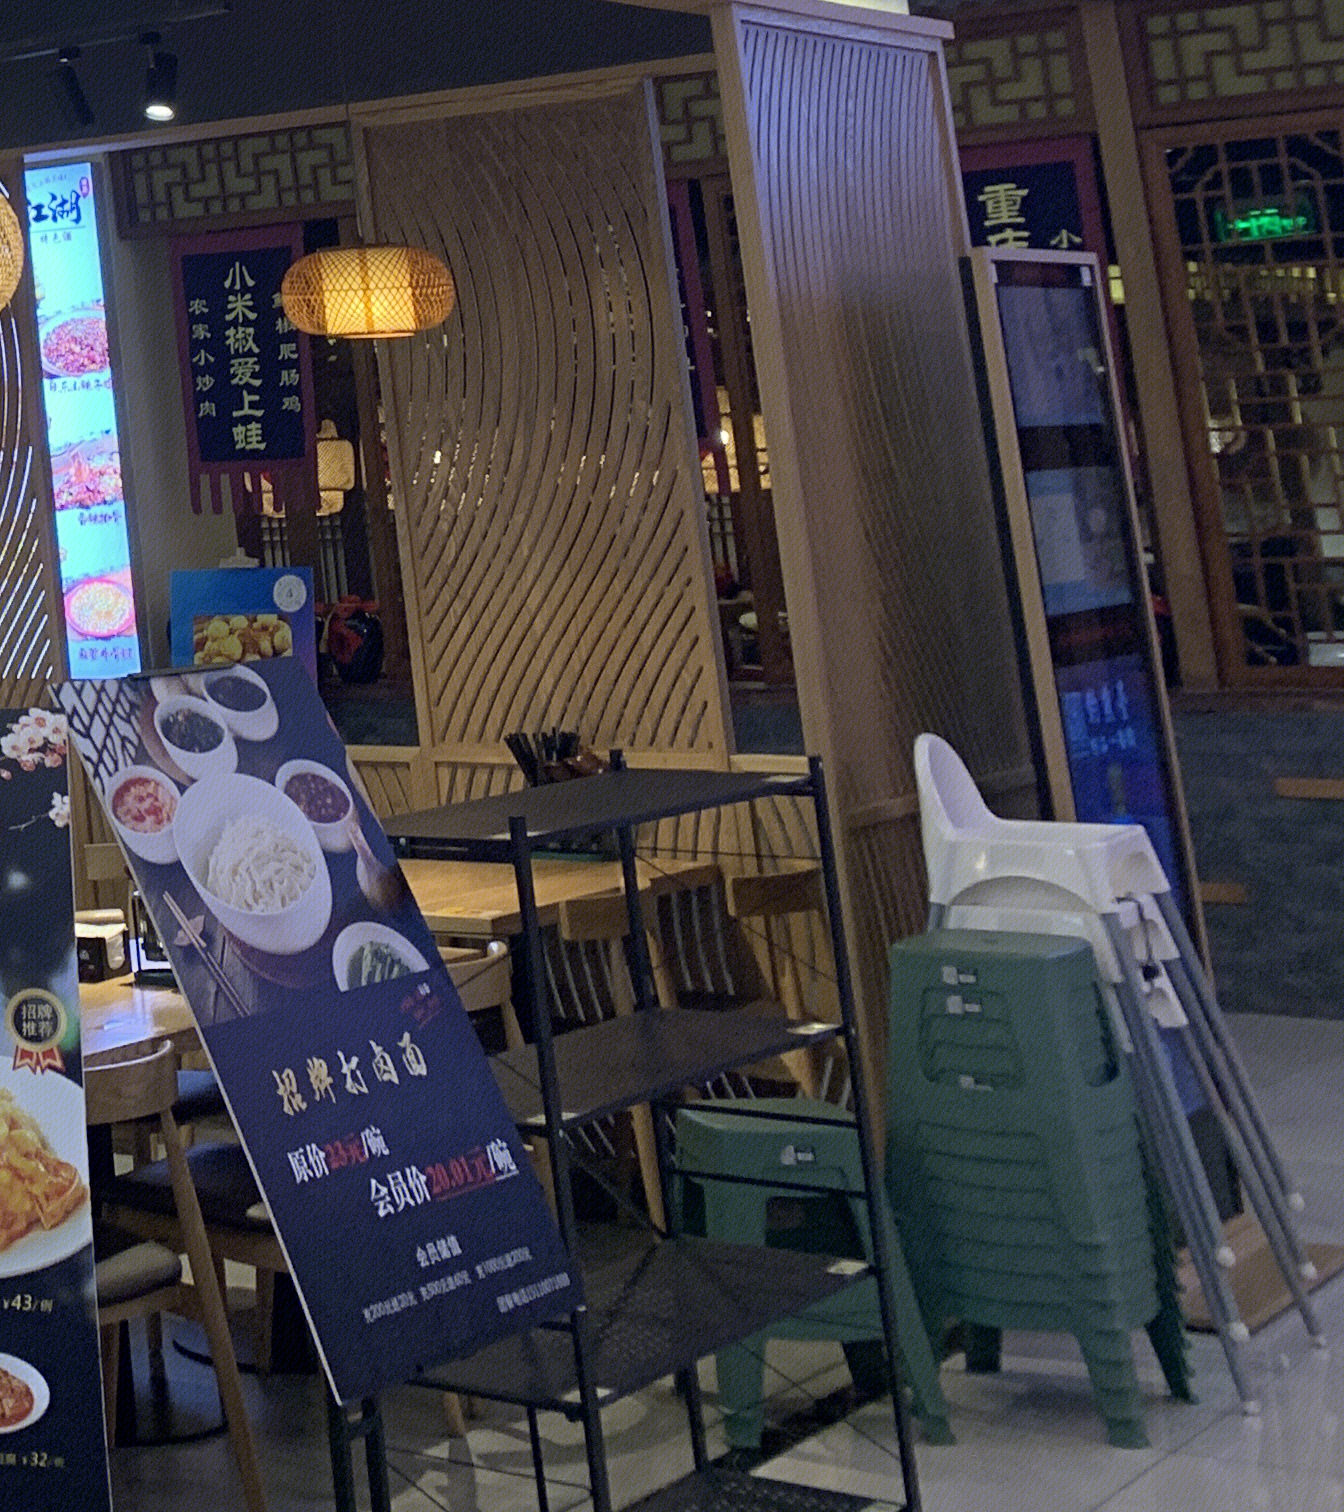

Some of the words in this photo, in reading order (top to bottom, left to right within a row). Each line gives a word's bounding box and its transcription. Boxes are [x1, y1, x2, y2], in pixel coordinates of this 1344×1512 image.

[187, 297, 217, 418] 农家小炒肉
[223, 261, 267, 451] 小米椒爱上蛙
[272, 1031, 429, 1117] 招牌打卤面
